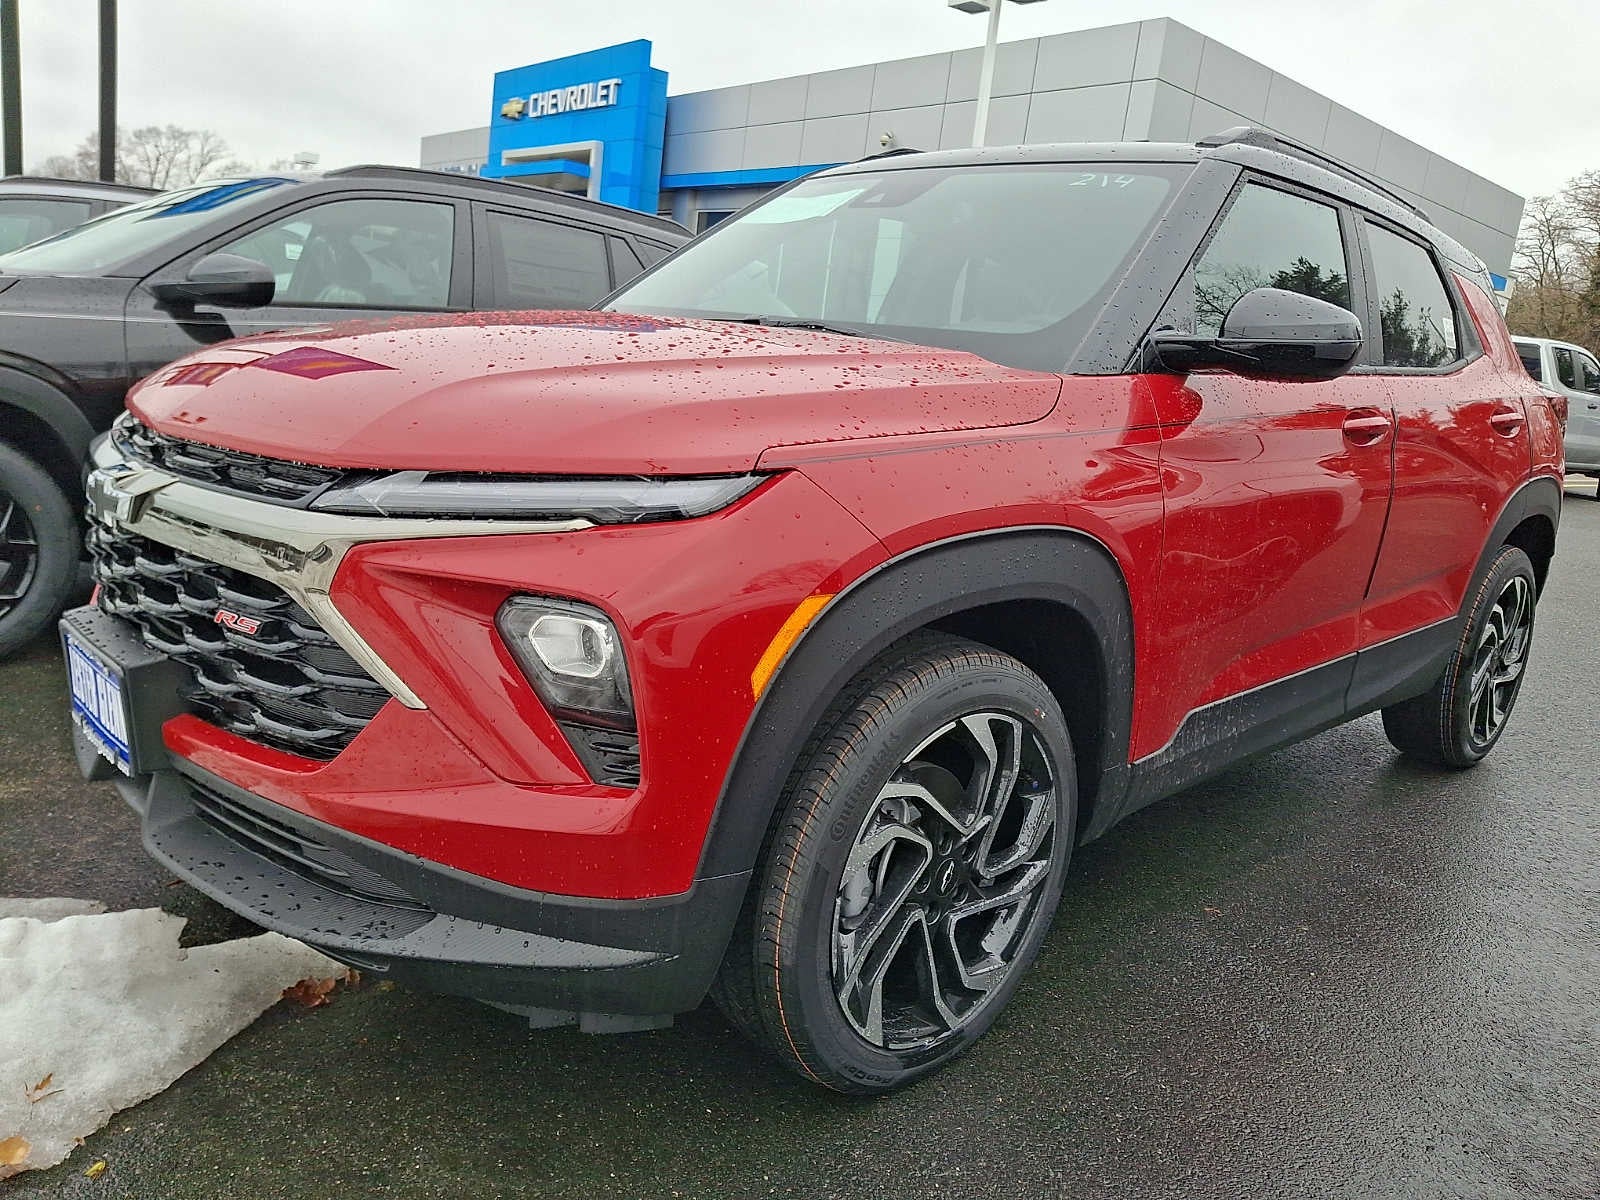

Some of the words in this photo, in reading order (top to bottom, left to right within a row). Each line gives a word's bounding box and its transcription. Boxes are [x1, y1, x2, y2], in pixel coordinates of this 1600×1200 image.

[528, 78, 622, 118] CHEVROLET
[1068, 173, 1135, 188] 214
[214, 610, 260, 634] RS
